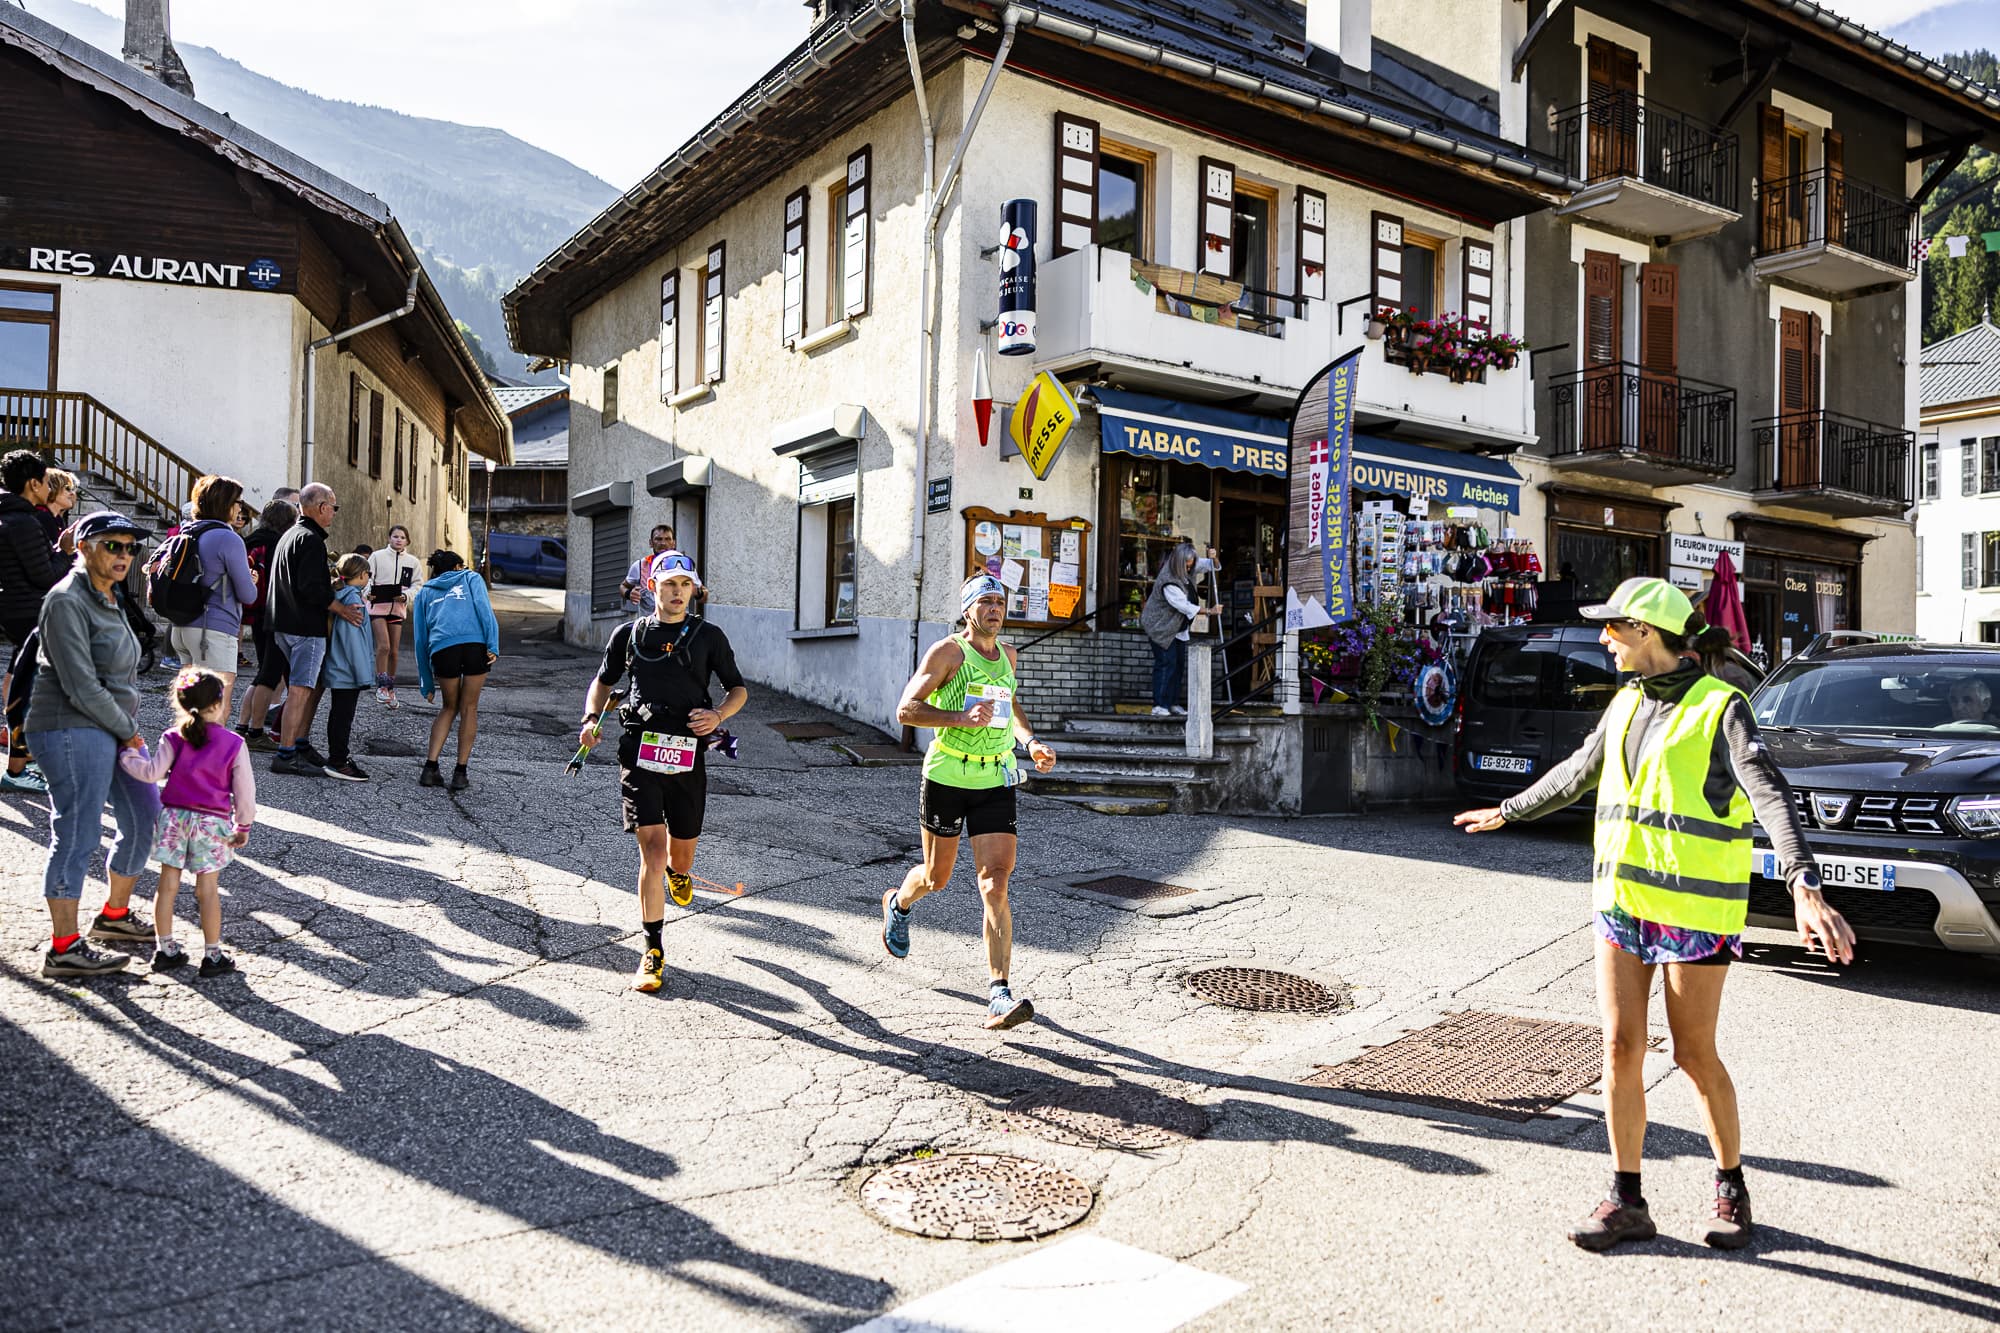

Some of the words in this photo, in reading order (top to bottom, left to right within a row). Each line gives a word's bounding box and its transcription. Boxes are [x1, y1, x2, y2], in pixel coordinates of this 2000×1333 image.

[1030, 410, 1065, 470] PRESSE
[1124, 426, 1200, 458] TABAC
[1232, 444, 1287, 472] PRES
[1023, 489, 1029, 498] 3
[1353, 465, 1448, 497] OUVENIRS
[1462, 482, 1509, 506] Arêches
[1674, 538, 1707, 551] FLEURON
[1693, 553, 1699, 562] la
[1785, 577, 1808, 592] Chez
[1815, 581, 1843, 596] DEDE
[653, 747, 682, 764] 1005
[1883, 878, 1895, 888] 73
